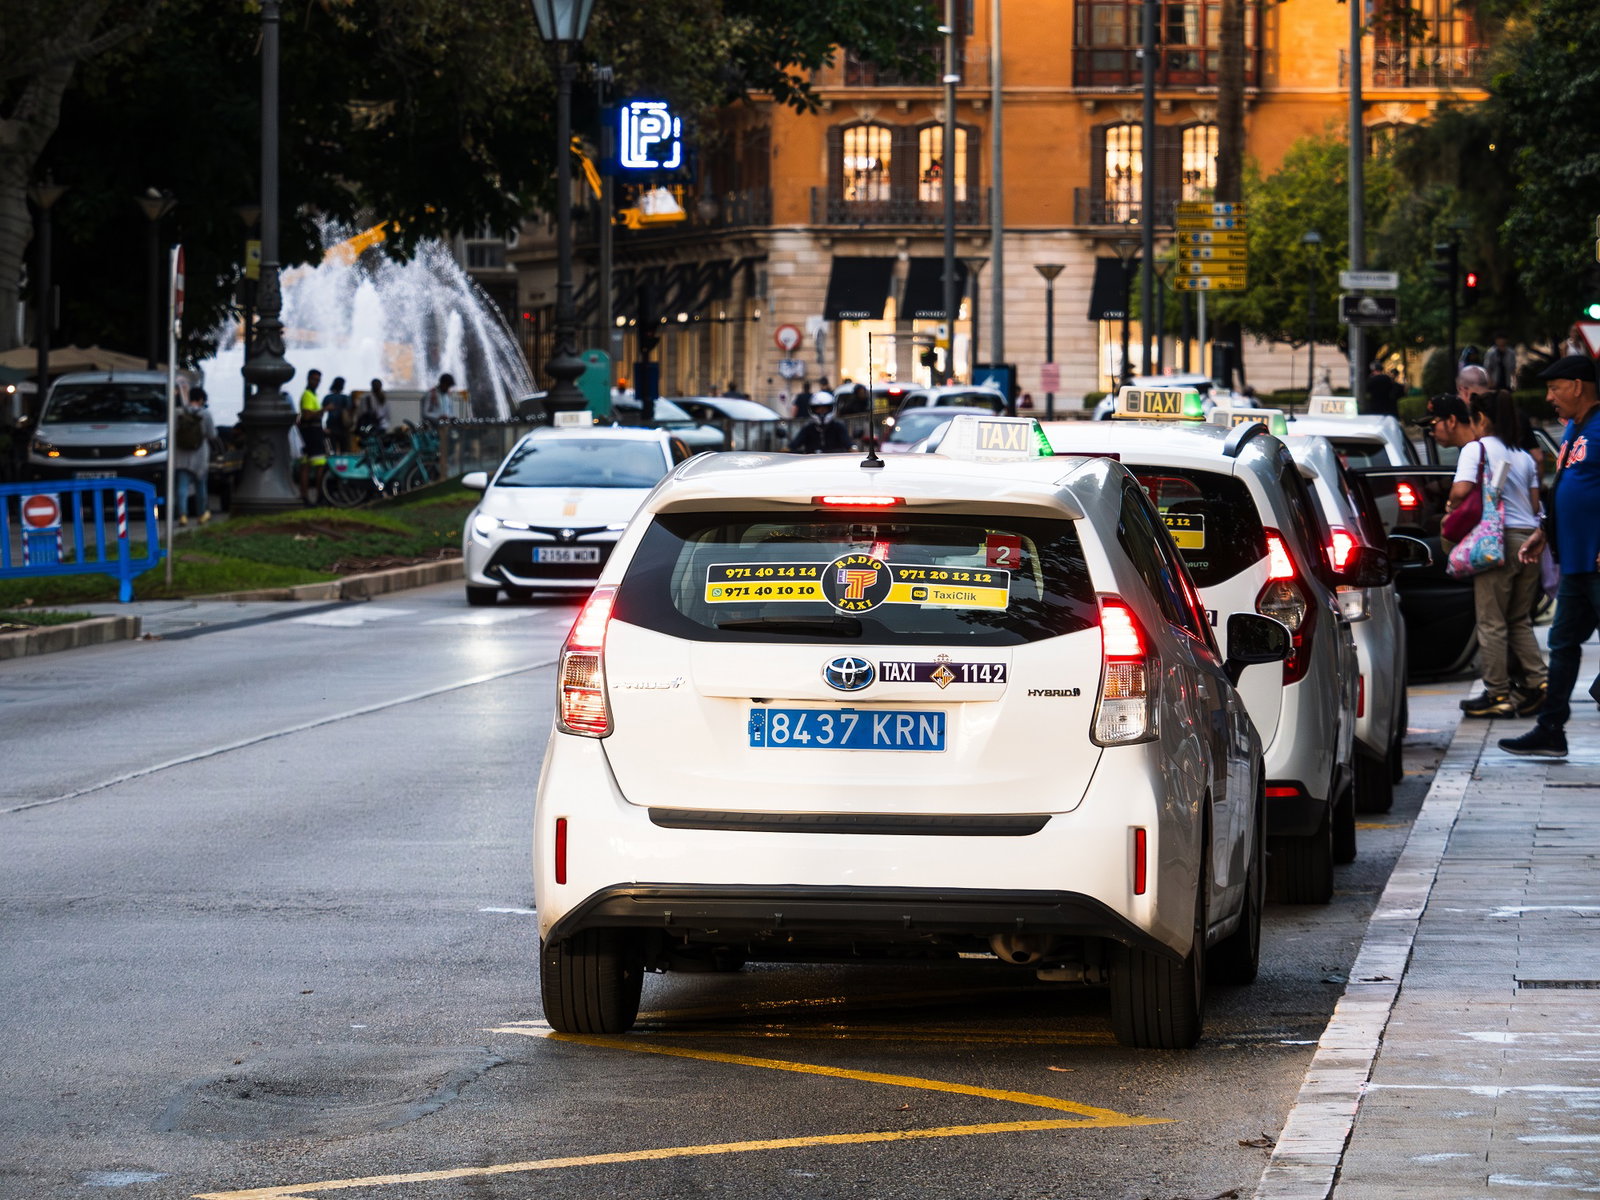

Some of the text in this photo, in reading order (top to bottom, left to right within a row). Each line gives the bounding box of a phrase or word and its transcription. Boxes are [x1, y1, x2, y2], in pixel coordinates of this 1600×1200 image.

[1145, 392, 1181, 413] TAXI
[1322, 401, 1344, 413] TAXI
[980, 422, 1027, 449] TAXI
[1177, 518, 1191, 526] 12
[996, 546, 1011, 565] 2
[835, 556, 882, 570] RADIO
[725, 567, 817, 578] 971 40 14 14
[899, 569, 992, 583] 971 20 12 12
[725, 586, 815, 597] 971 40 10 10
[933, 591, 977, 601] TaxiClik
[838, 598, 873, 610] TAXI
[882, 662, 1004, 683] TAXI 1142
[1028, 689, 1073, 697] HYBRID
[771, 713, 940, 747] 8437 KRN
[754, 732, 761, 741] E
